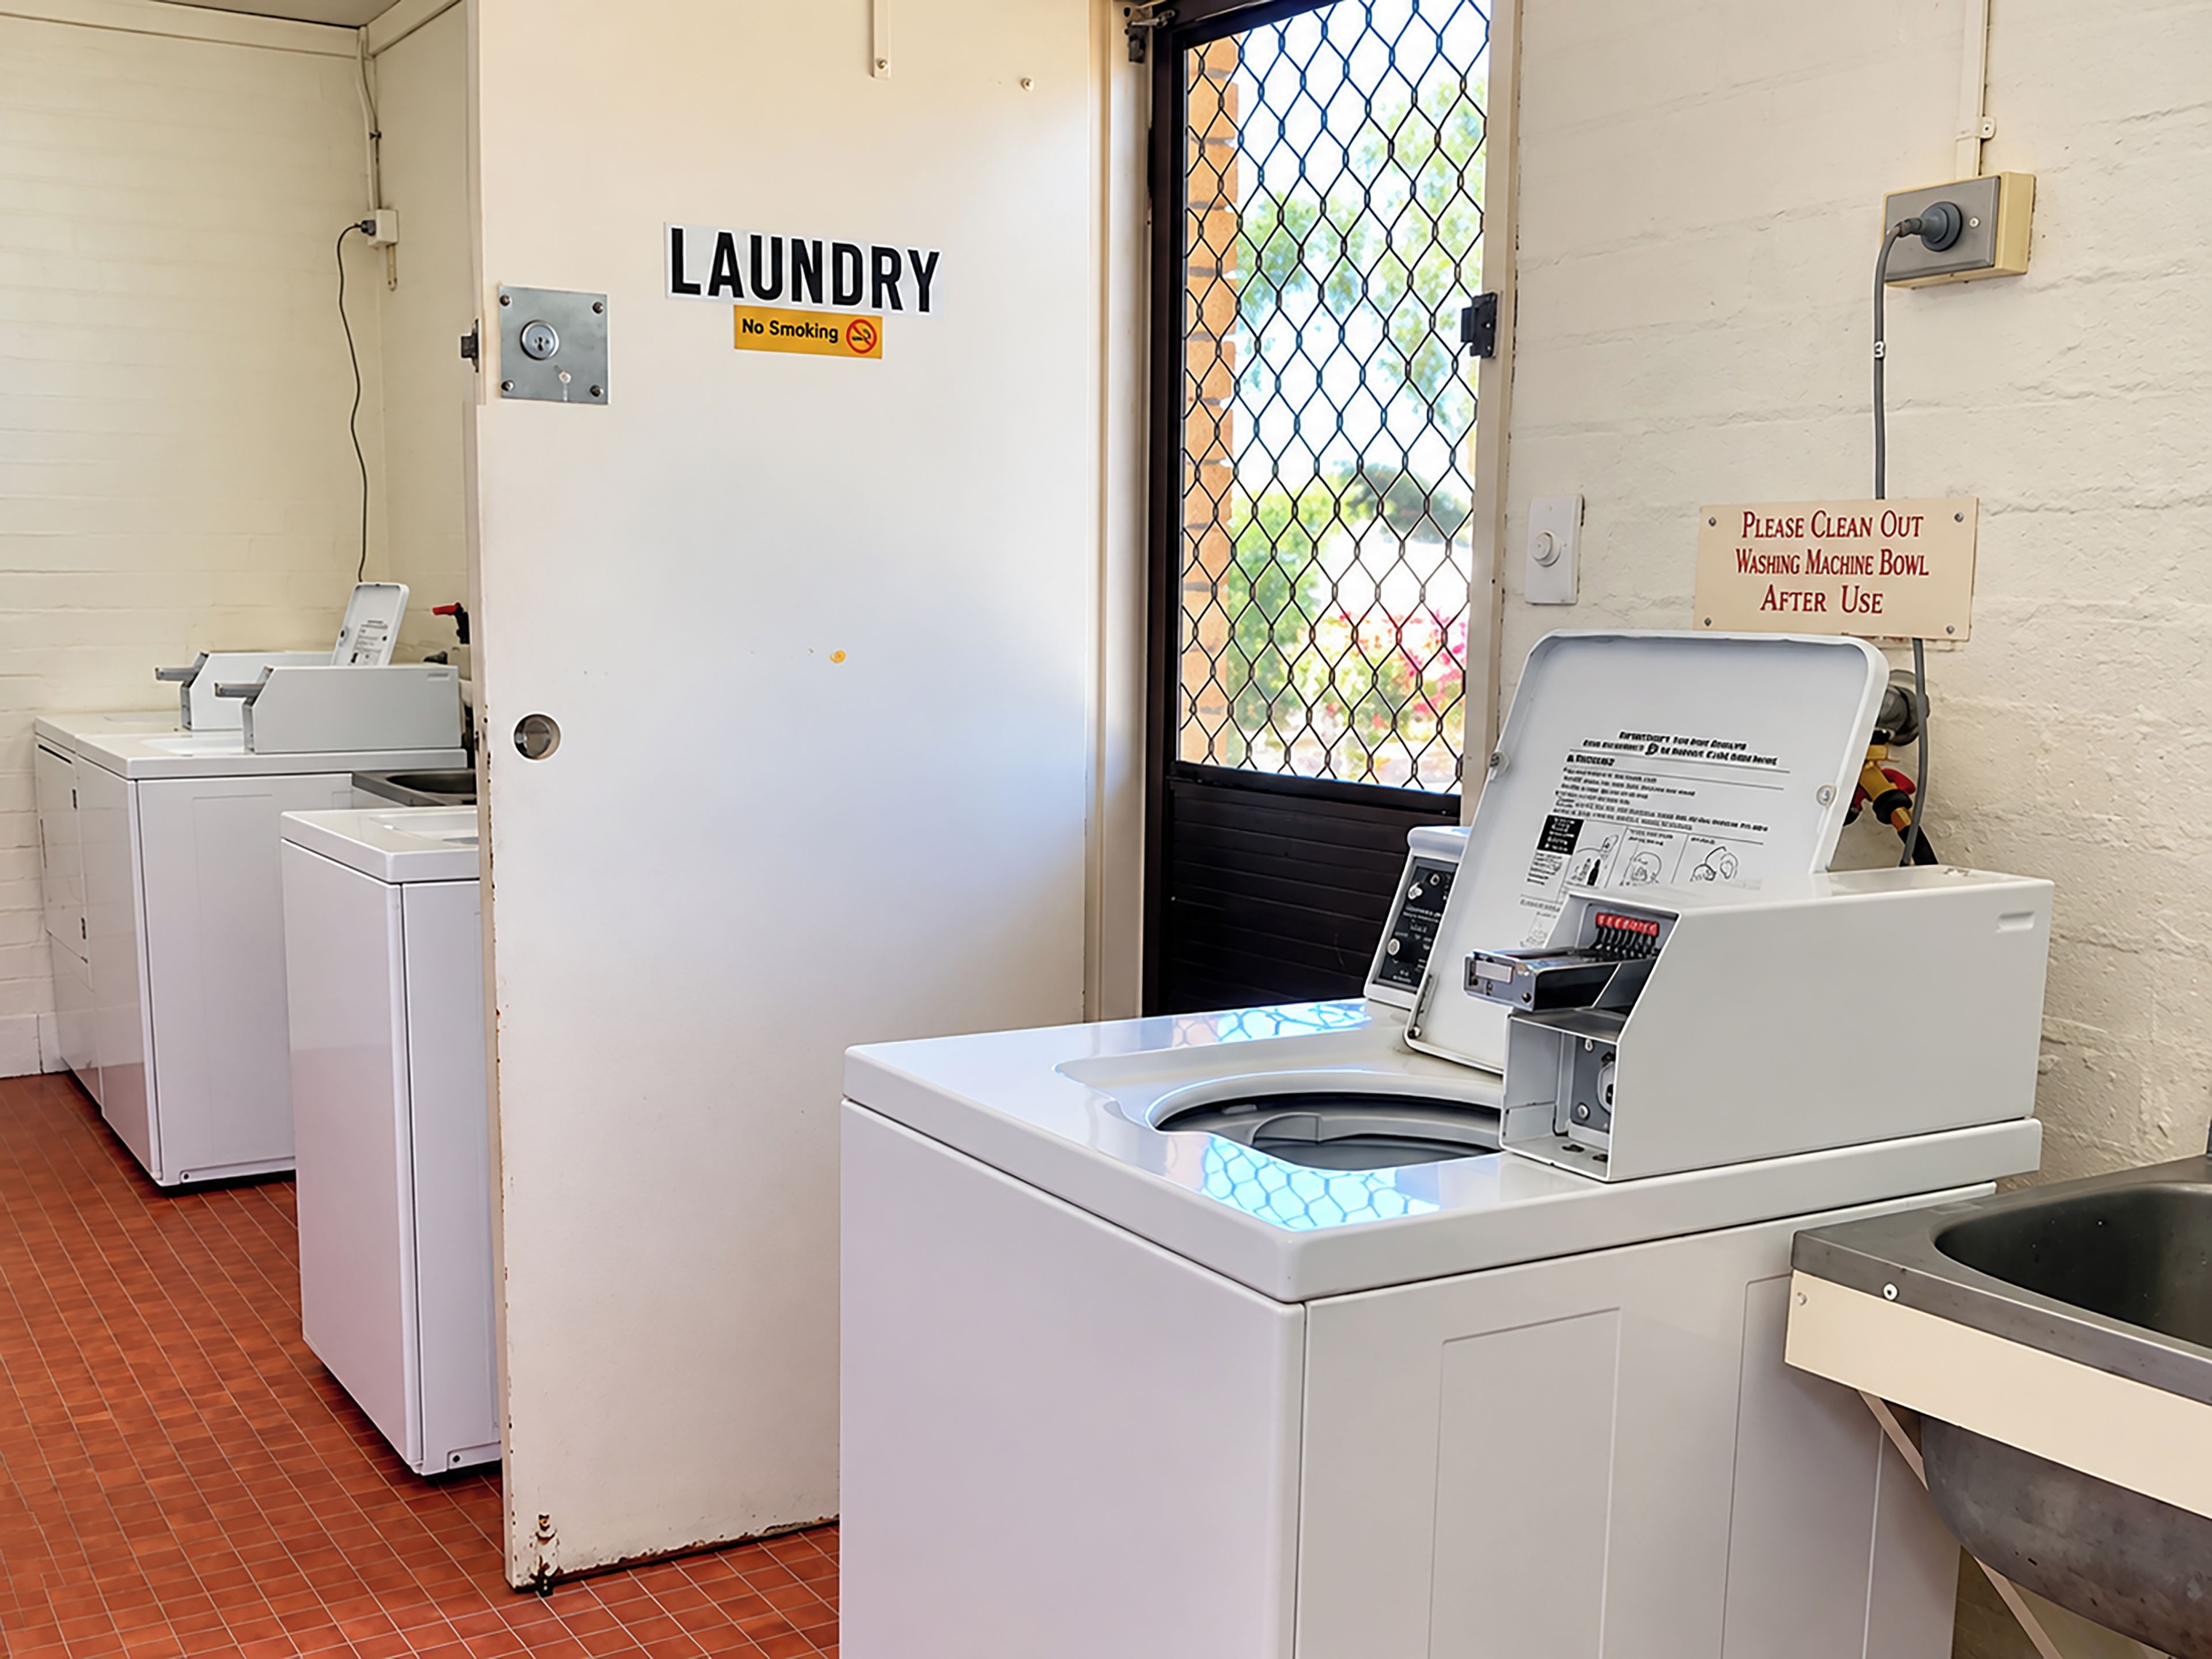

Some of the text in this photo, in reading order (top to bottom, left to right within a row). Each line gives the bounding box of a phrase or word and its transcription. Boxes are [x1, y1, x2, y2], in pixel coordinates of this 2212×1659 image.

[671, 228, 940, 313] LAUNDRY
[742, 318, 839, 343] No Smoking
[1741, 509, 1924, 539] PLEASE CLEAN OUT
[1735, 548, 1929, 576] WASHING MACHINE BOWL
[1760, 584, 1884, 614] AFTER USE
